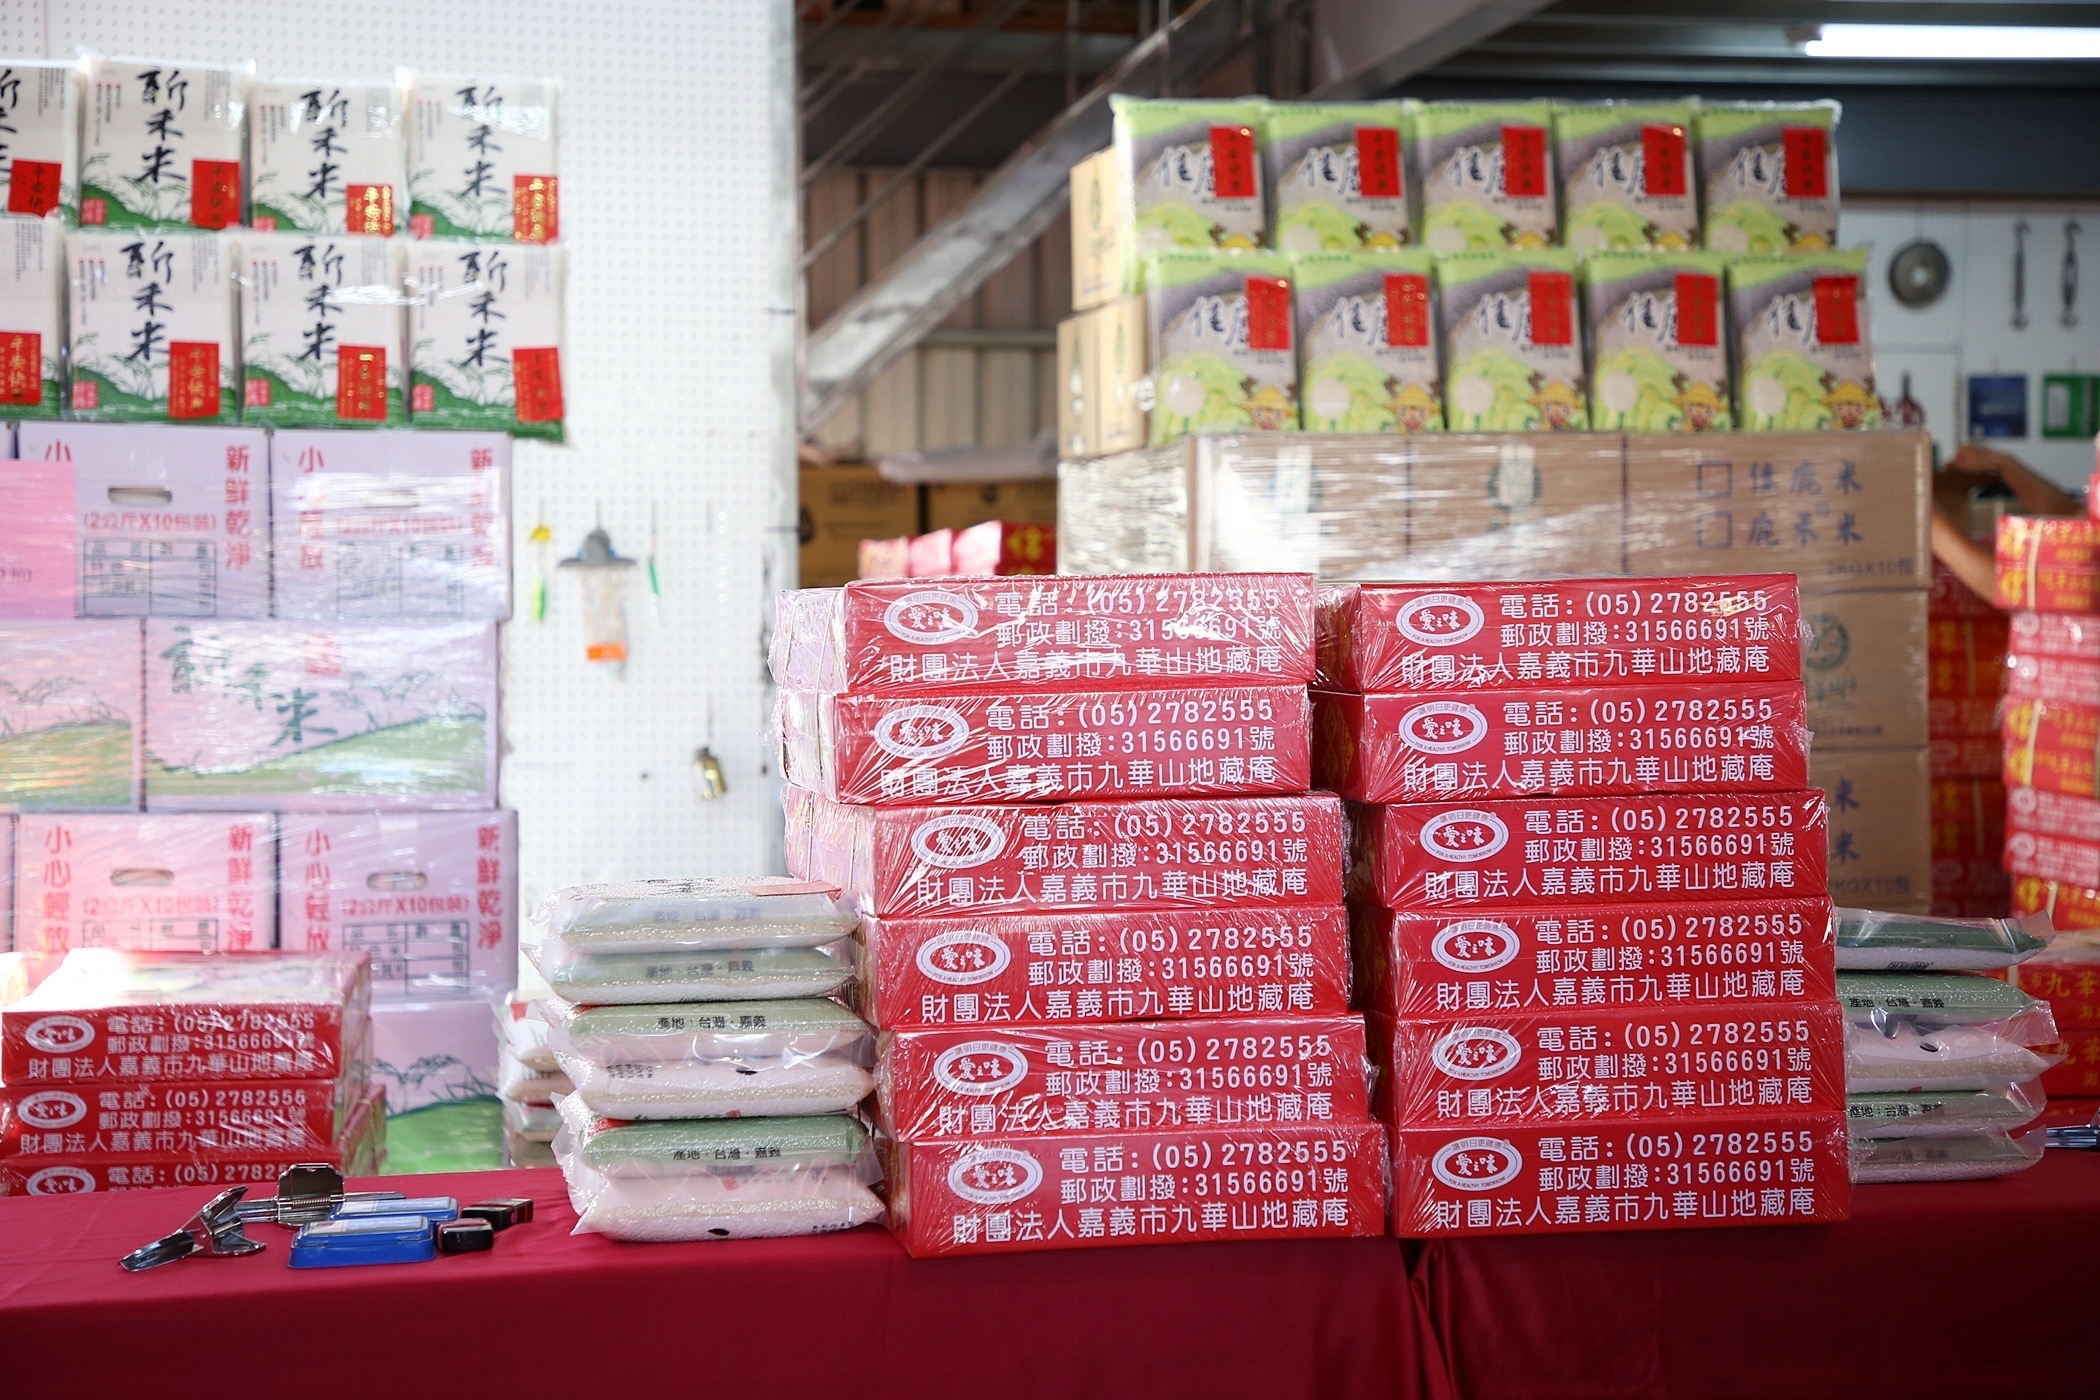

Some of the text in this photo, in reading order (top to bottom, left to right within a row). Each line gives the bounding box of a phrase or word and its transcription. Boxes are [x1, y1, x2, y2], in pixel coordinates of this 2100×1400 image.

[225, 445, 250, 570] 新鮮乾淨
[1419, 610, 1461, 632] 愛之味
[1423, 717, 1462, 740] 愛之味
[1444, 825, 1486, 850] 愛之味
[477, 825, 502, 949] 新鮮乾淨
[1455, 936, 1496, 958] 愛之味
[1457, 1153, 1498, 1176] 愛之味
